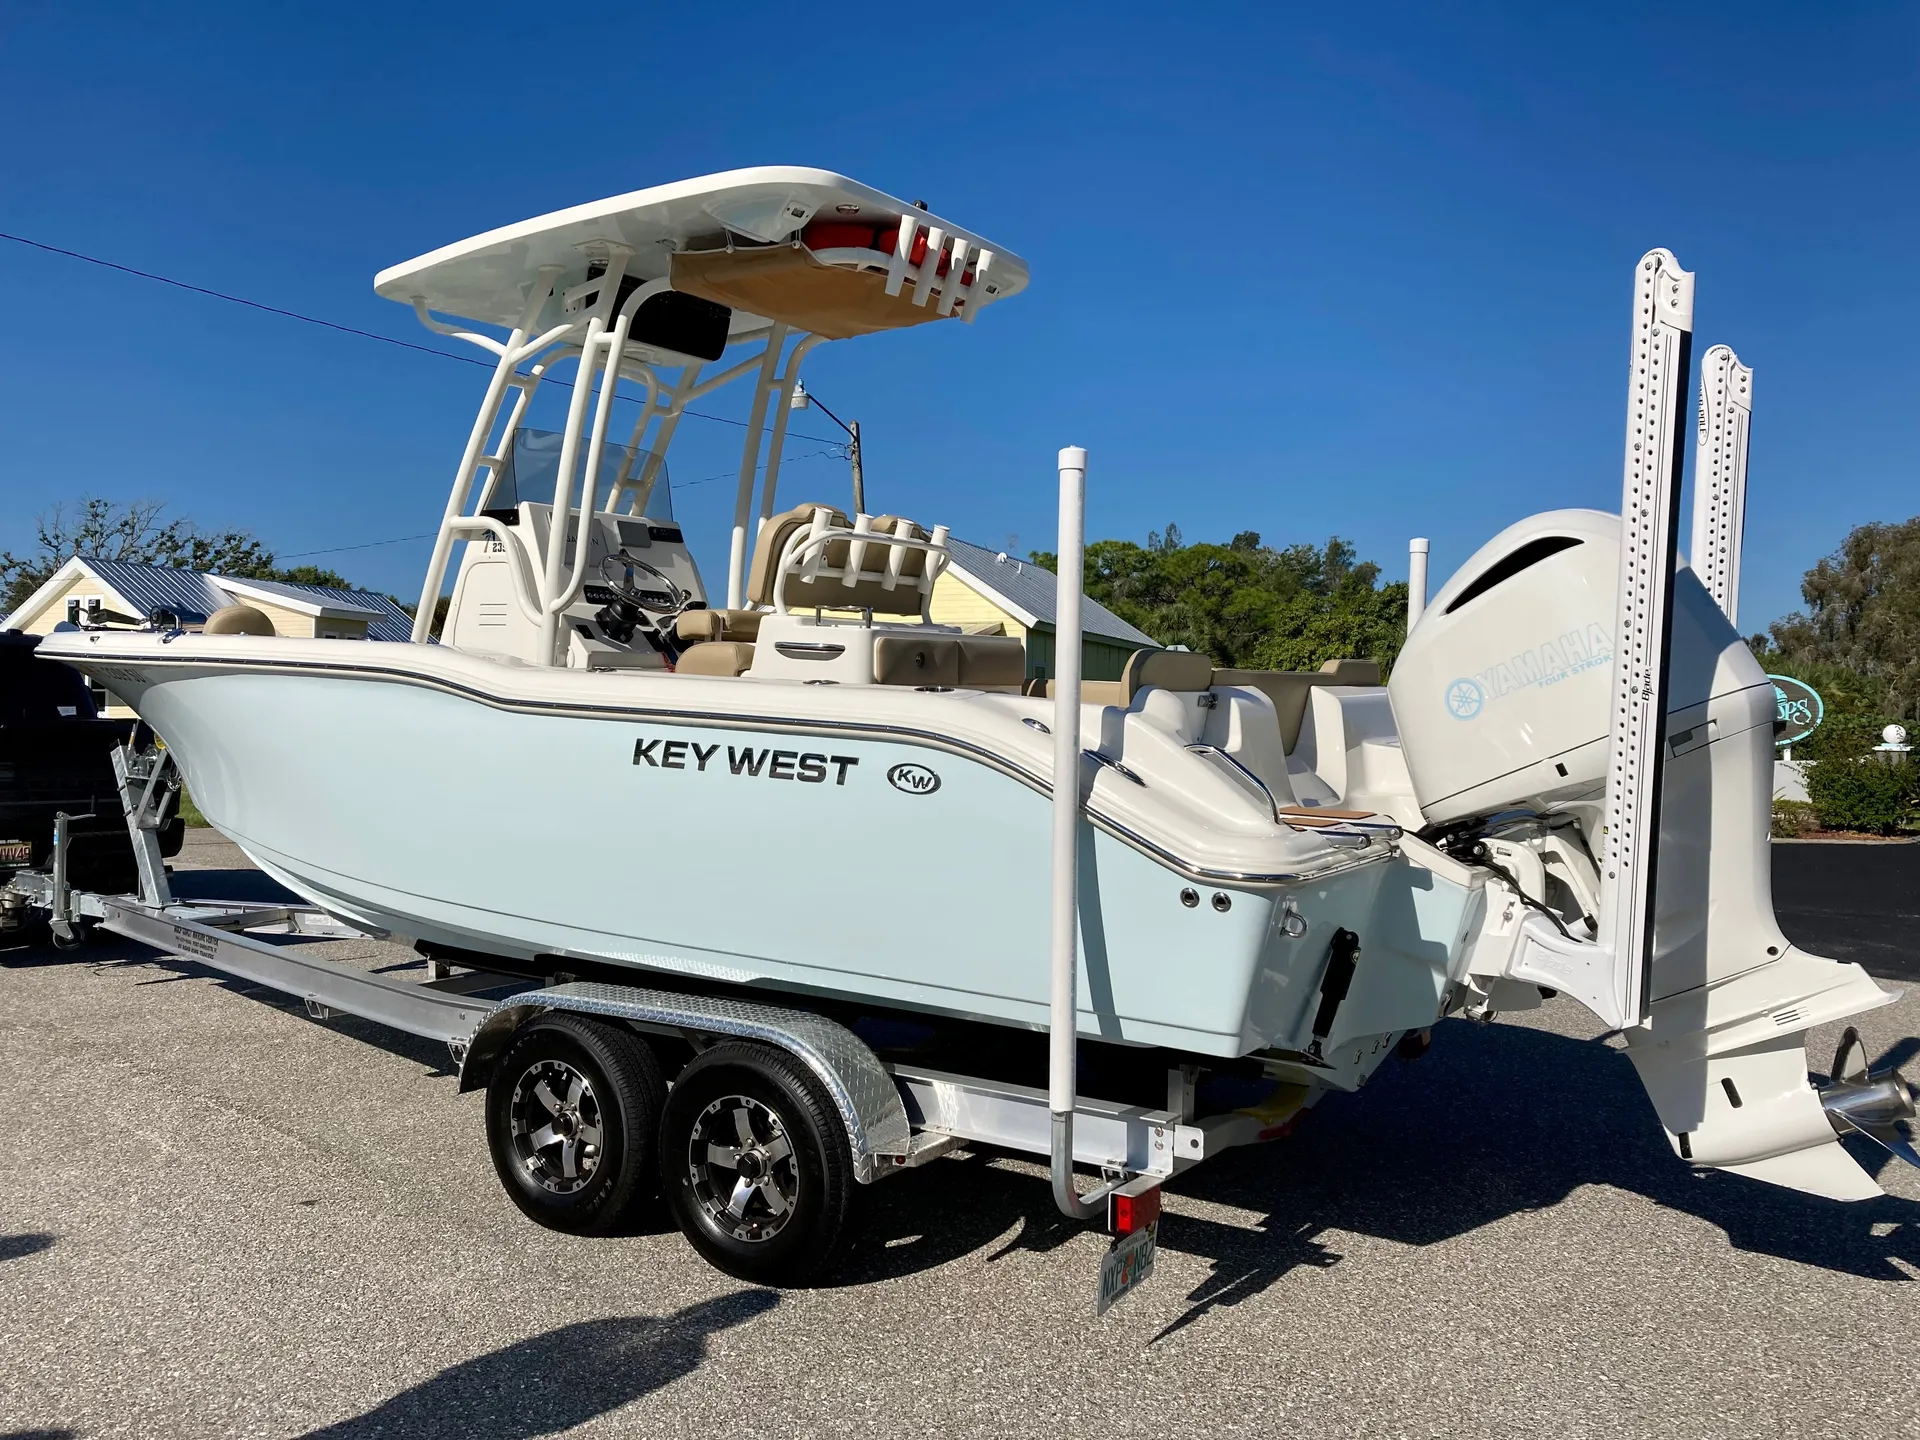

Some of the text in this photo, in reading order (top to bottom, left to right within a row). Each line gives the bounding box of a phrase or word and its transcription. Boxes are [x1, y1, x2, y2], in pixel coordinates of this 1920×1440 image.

[1475, 622, 1615, 700] YAMAHA
[1539, 653, 1614, 689] FOUR STROK
[1642, 669, 1655, 701] Blade
[632, 738, 860, 786] KEY WEST
[897, 768, 933, 790] KW
